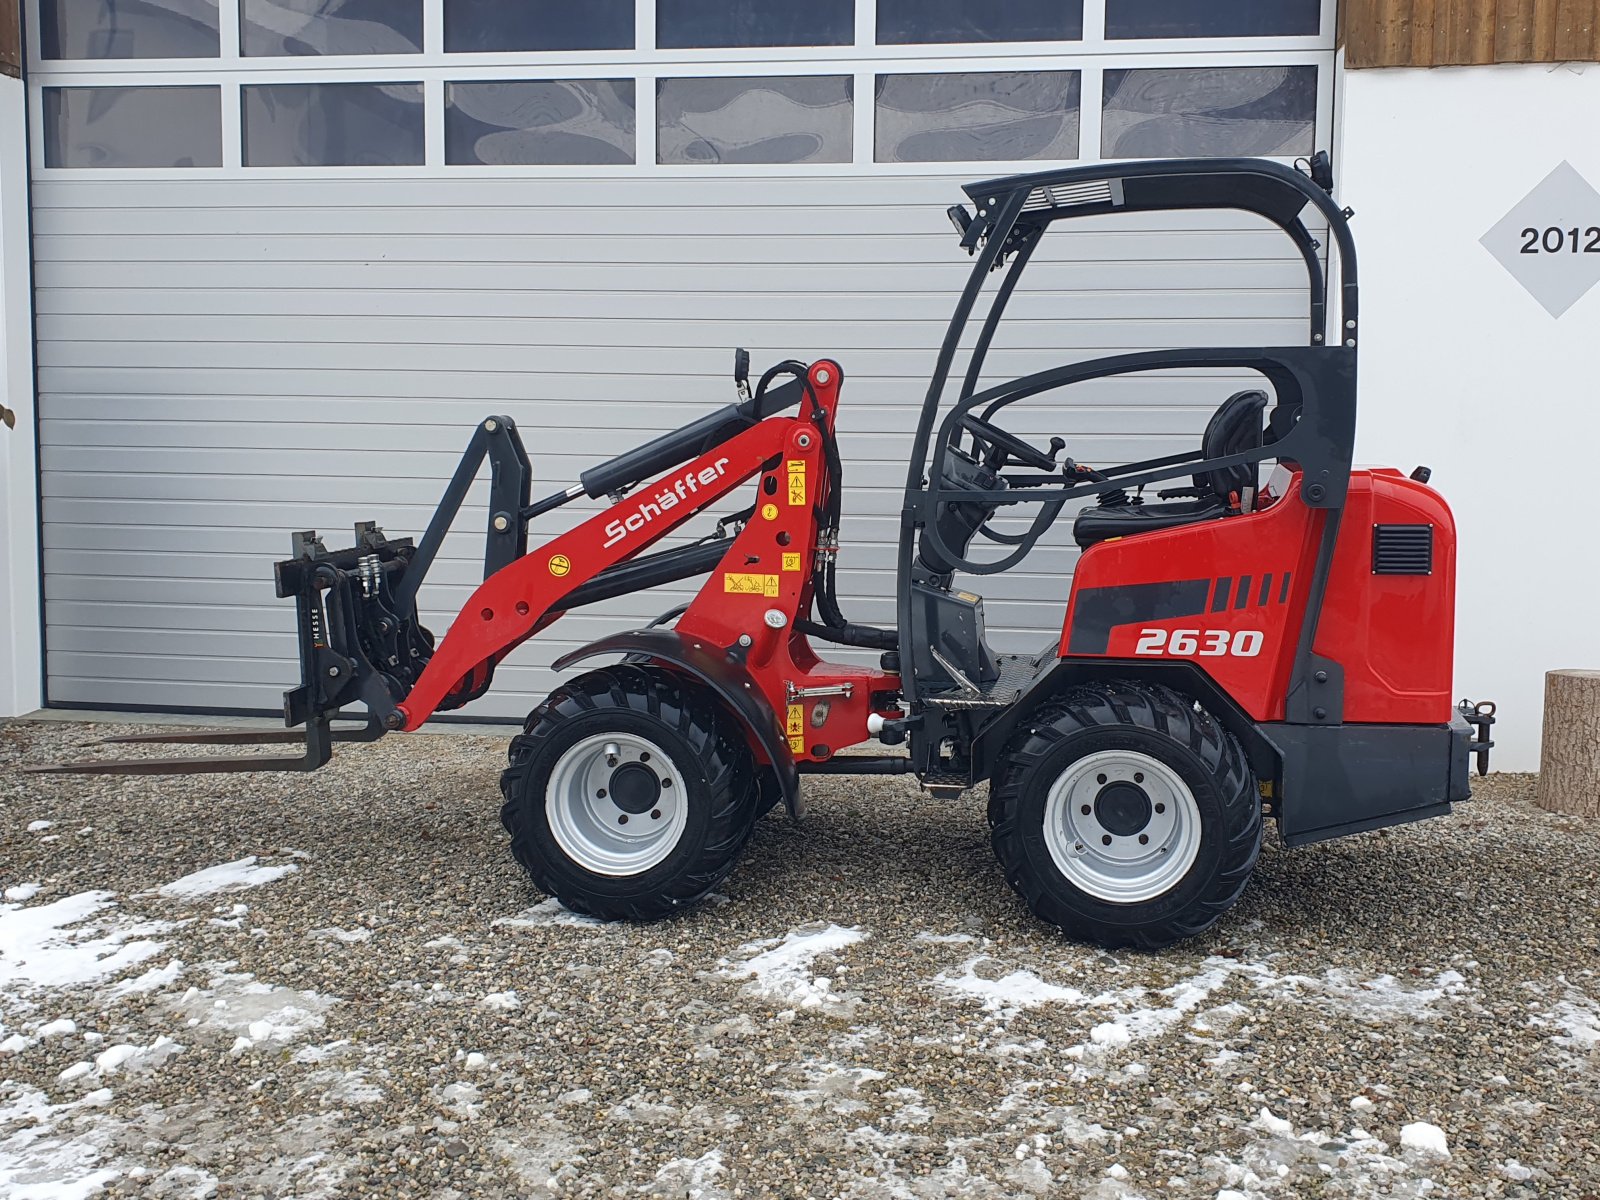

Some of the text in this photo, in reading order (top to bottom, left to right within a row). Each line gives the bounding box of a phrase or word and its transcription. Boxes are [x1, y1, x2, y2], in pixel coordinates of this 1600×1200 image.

[1520, 227, 1600, 254] 2012
[603, 457, 729, 549] Schäffer
[311, 608, 320, 639] HESSE
[1135, 628, 1264, 656] 2630
